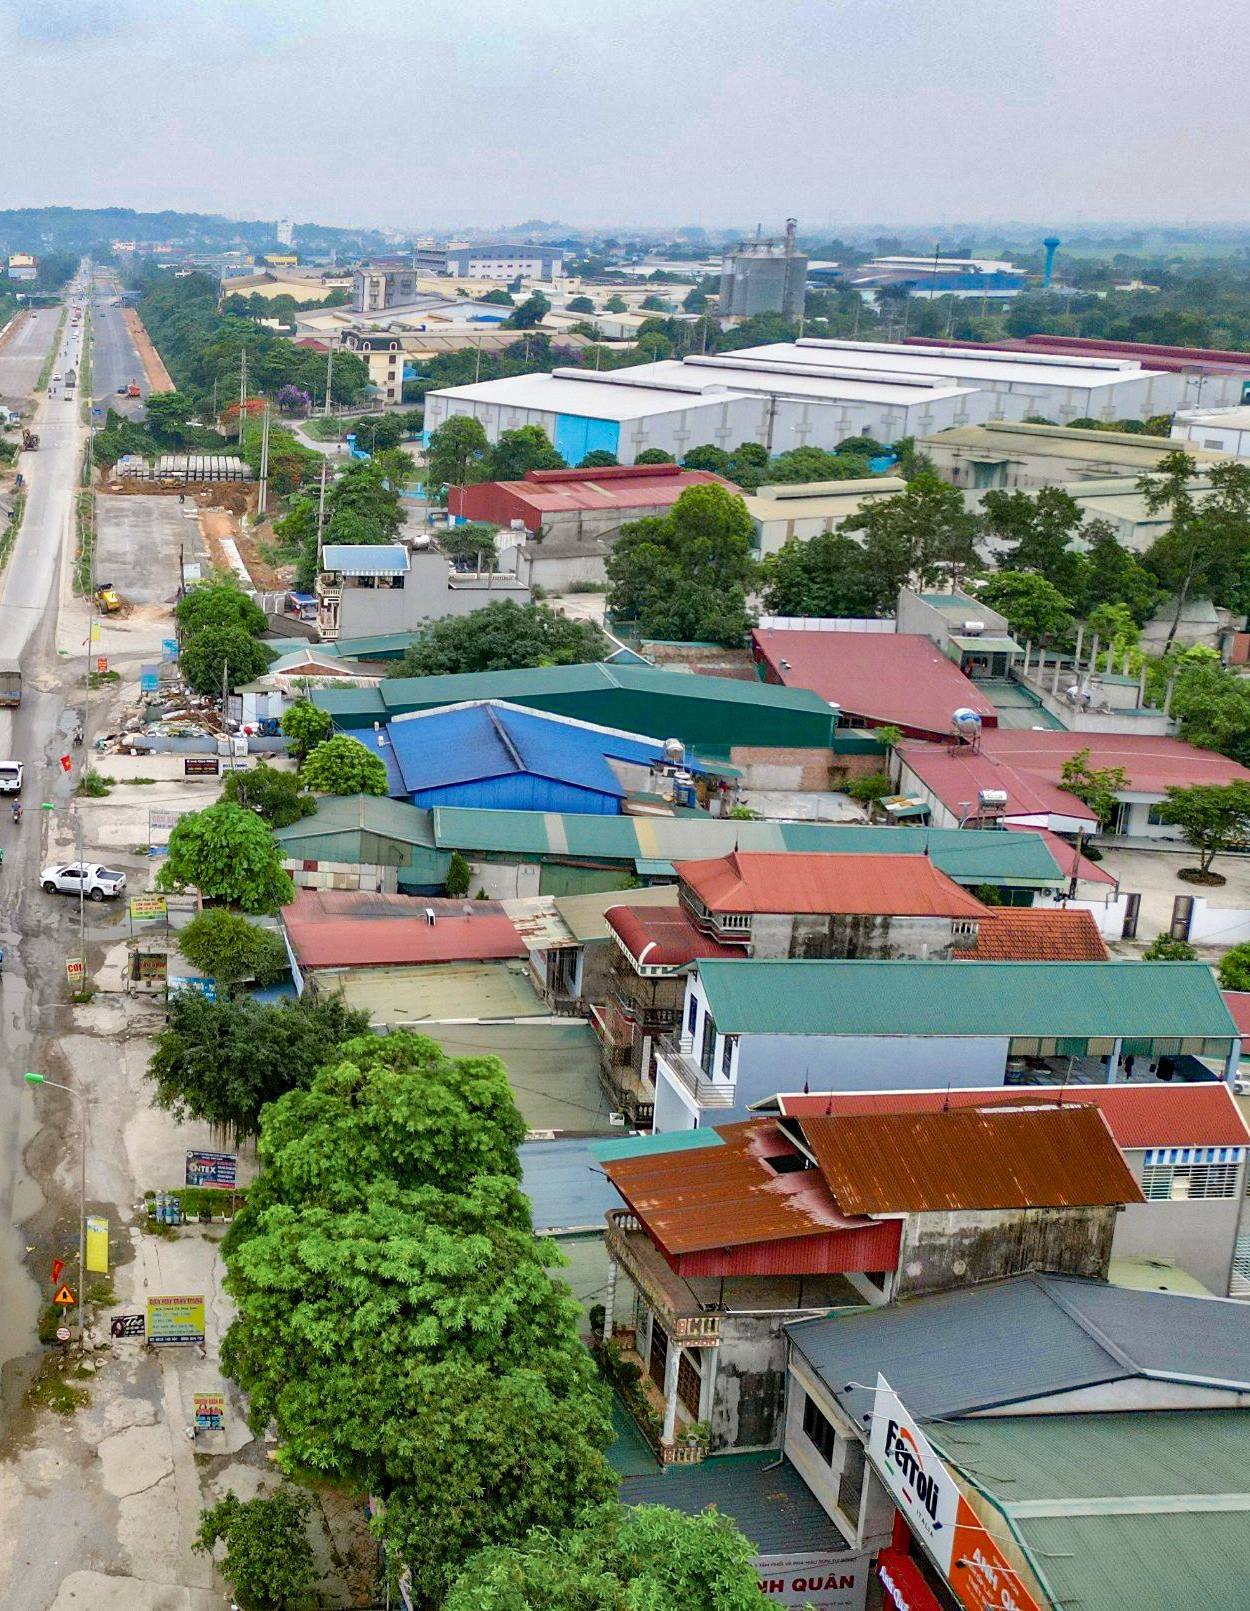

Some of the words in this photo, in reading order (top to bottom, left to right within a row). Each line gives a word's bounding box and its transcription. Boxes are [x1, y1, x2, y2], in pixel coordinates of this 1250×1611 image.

[885, 1419, 940, 1521] Ferroli
[757, 1579, 785, 1594] NH
[792, 1572, 855, 1592] QUÂN
